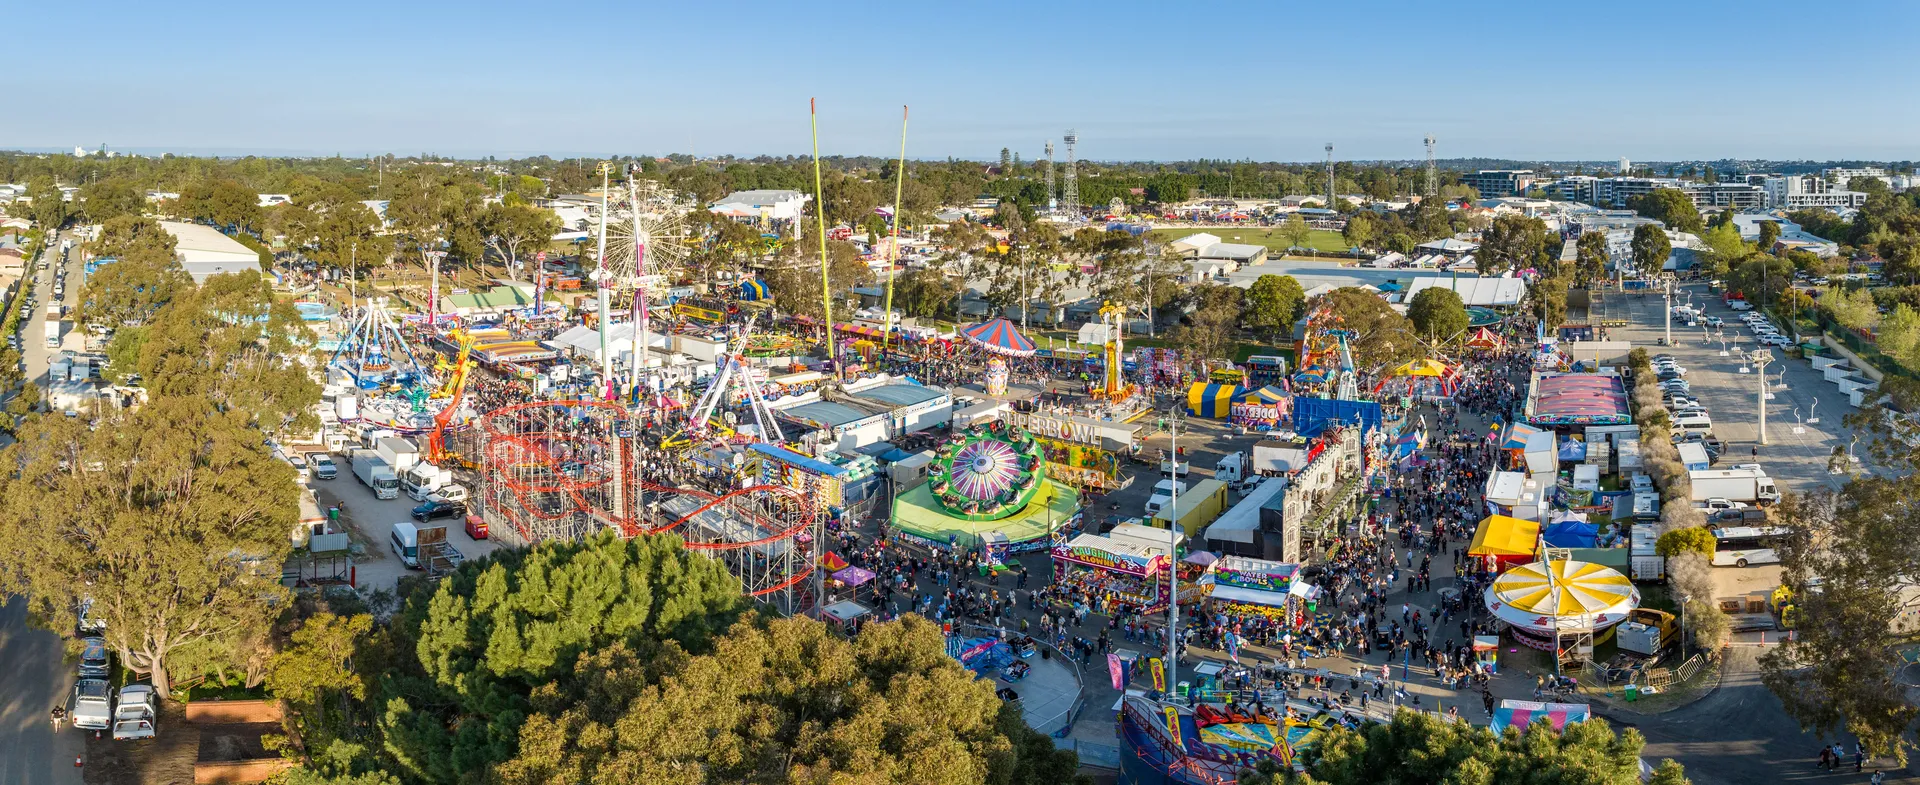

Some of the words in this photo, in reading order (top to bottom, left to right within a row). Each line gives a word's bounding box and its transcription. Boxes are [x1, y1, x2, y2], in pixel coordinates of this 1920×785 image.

[998, 409, 1101, 446] SUPERBOWL
[1072, 546, 1122, 564] LAUGHING
[1080, 555, 1115, 568] CLOWNS
[1238, 576, 1268, 586] BOWLS
[1239, 570, 1268, 579] WATER
